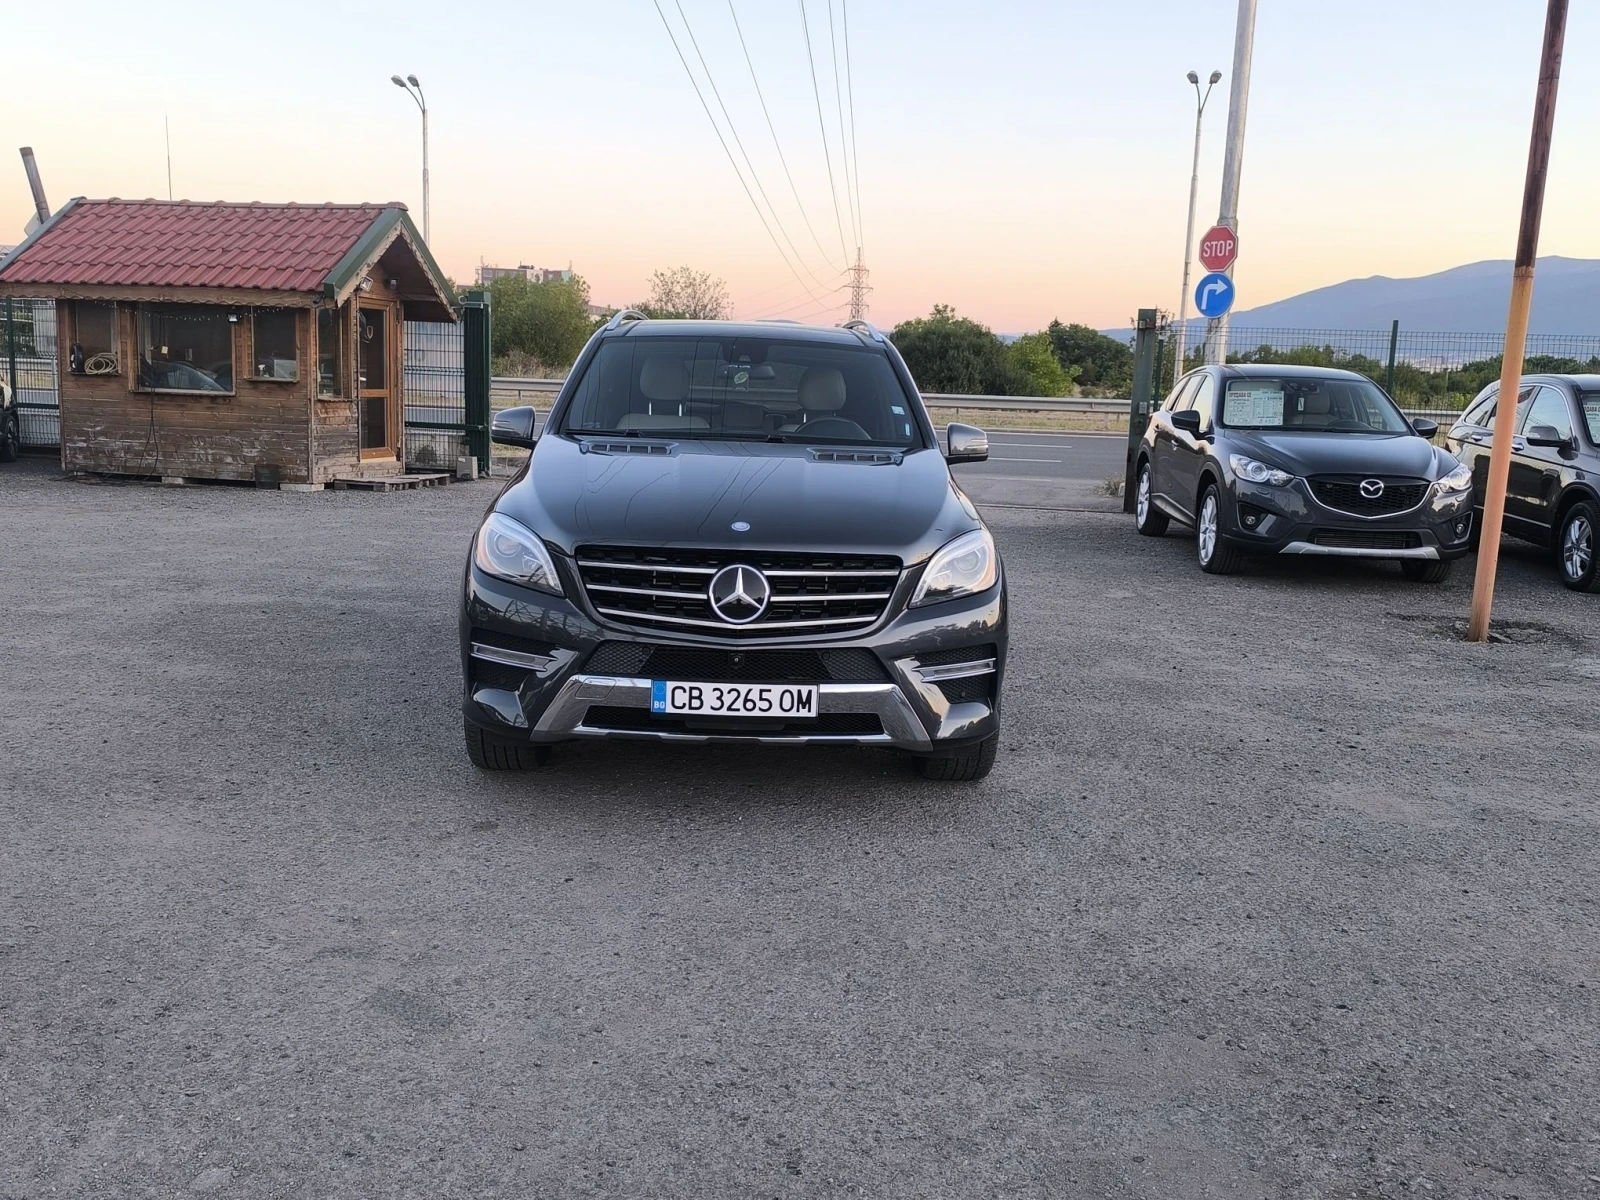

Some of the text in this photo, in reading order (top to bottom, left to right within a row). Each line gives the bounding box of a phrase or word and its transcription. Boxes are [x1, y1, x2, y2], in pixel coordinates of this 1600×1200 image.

[1203, 240, 1233, 257] STOP
[654, 701, 665, 709] BG
[671, 686, 813, 713] CB 3265 OM
